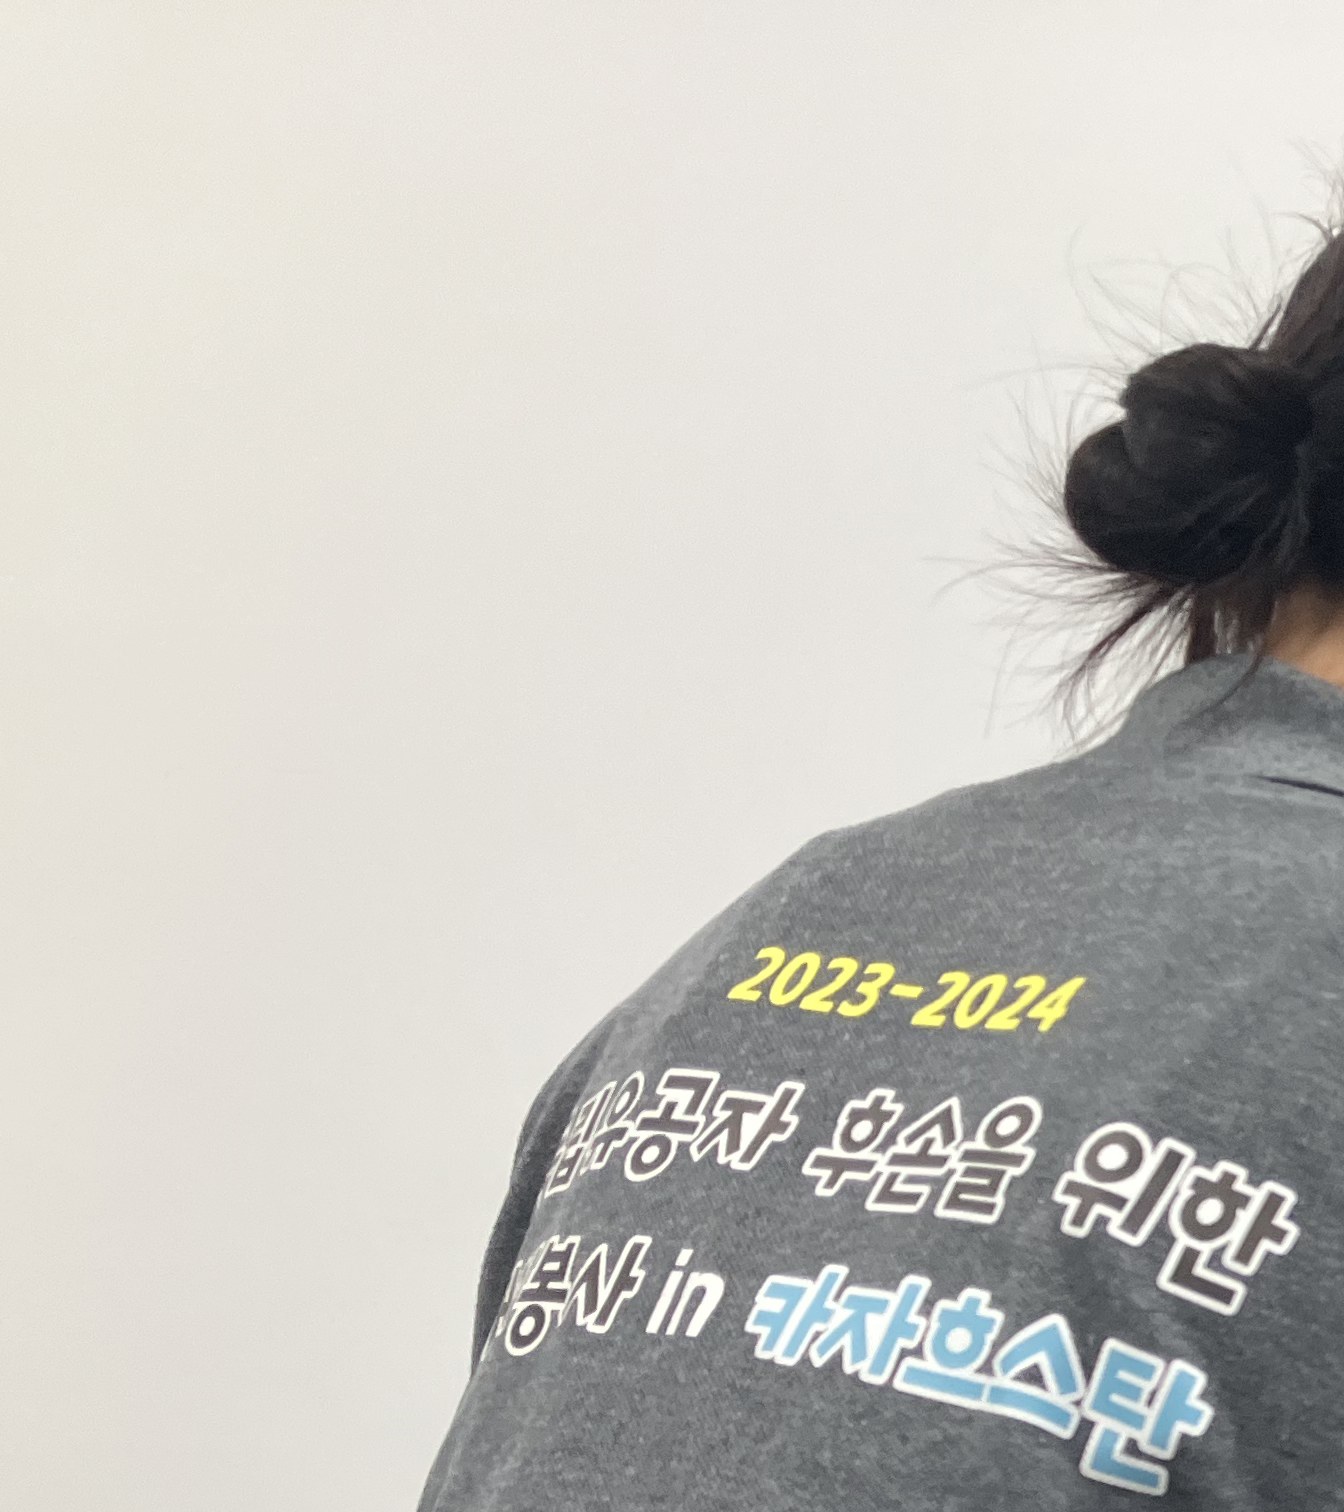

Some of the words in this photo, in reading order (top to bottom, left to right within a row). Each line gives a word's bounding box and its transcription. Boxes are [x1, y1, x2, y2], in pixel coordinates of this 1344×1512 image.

[727, 946, 1087, 1034] 2023-2024
[802, 1087, 1043, 1225] 후손을
[1053, 1121, 1300, 1316] 위한
[645, 1248, 727, 1338] in
[744, 1264, 1213, 1496] 카자흐스탄
